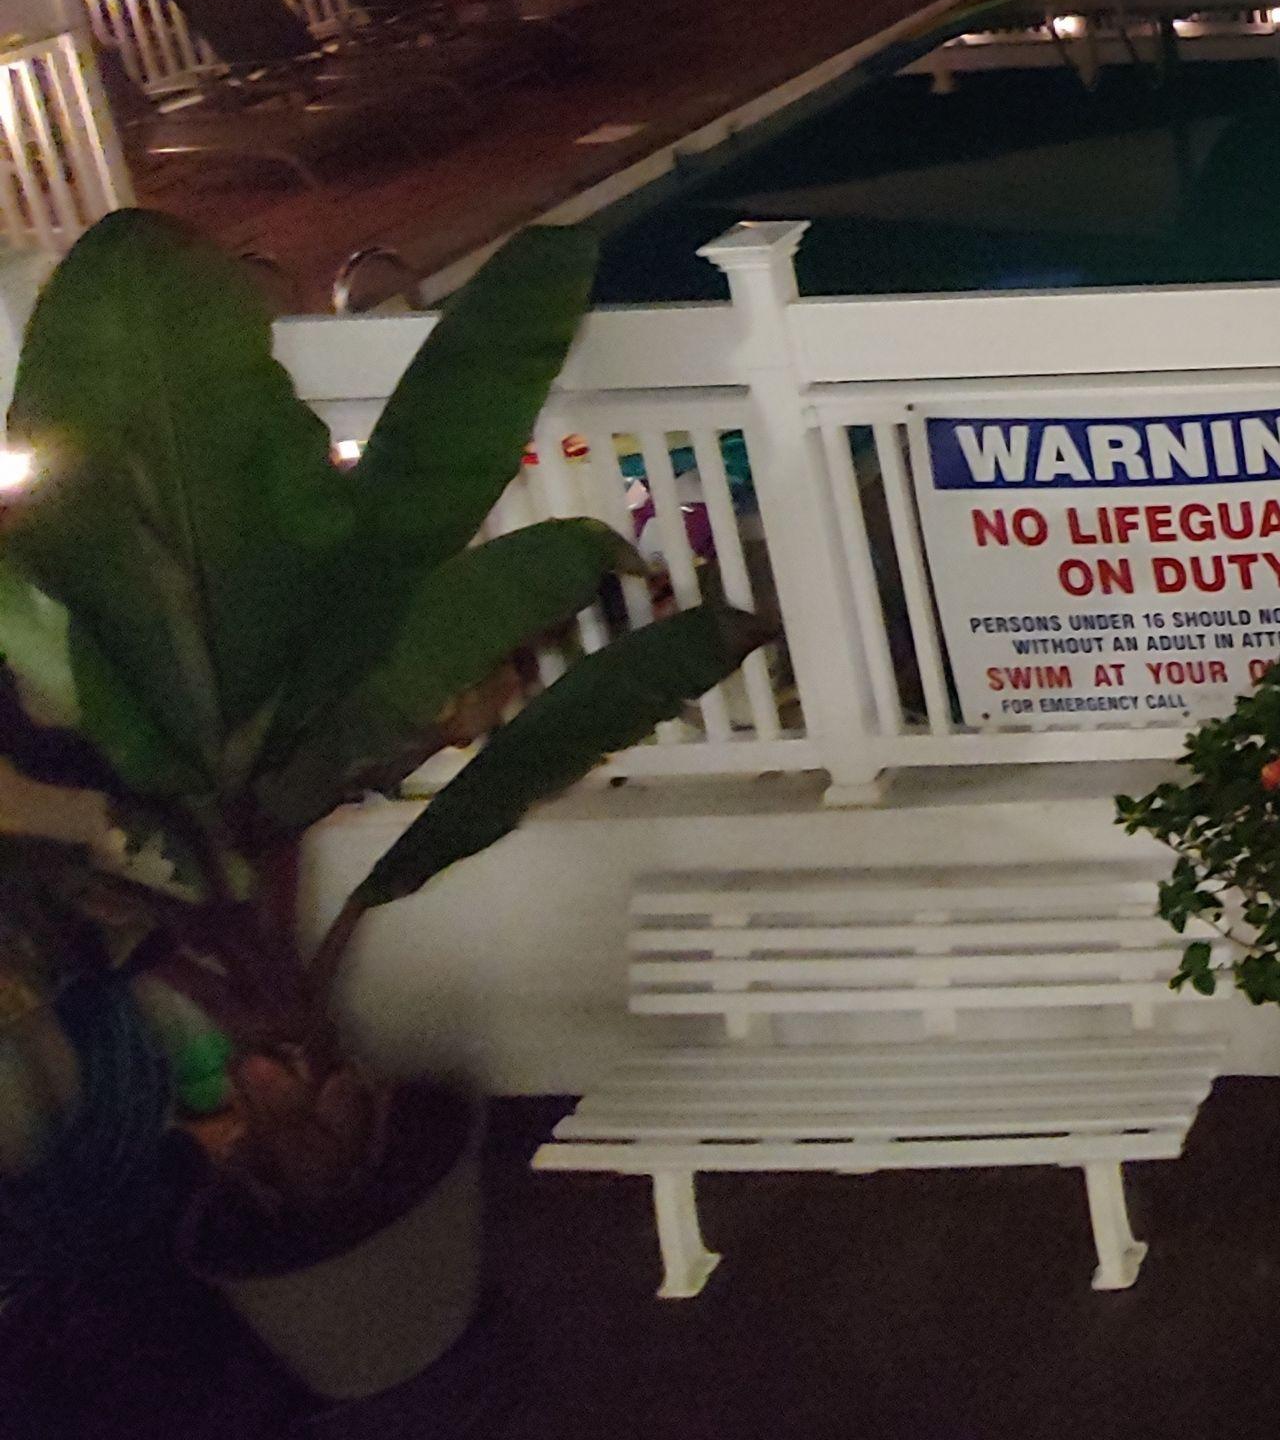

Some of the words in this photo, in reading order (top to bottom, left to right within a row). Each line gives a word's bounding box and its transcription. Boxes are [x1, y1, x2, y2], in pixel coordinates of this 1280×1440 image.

[972, 508, 1048, 547] NO
[1058, 558, 1134, 596] ON
[970, 615, 1061, 634] PERSONS
[1069, 612, 1135, 631] UNDER
[1142, 612, 1164, 630] 16
[1171, 610, 1251, 629] SHOULD
[1012, 636, 1106, 655] WITHOUT
[1112, 635, 1139, 652] AN
[1146, 632, 1208, 651] ADULT
[1214, 633, 1234, 648] IN
[986, 665, 1072, 690] SWIM
[1093, 663, 1125, 685] AT
[1146, 659, 1228, 684] YOUR
[1001, 698, 1033, 714] FOR
[1039, 695, 1139, 713] EMERGENCY
[1145, 694, 1186, 709] CALL
